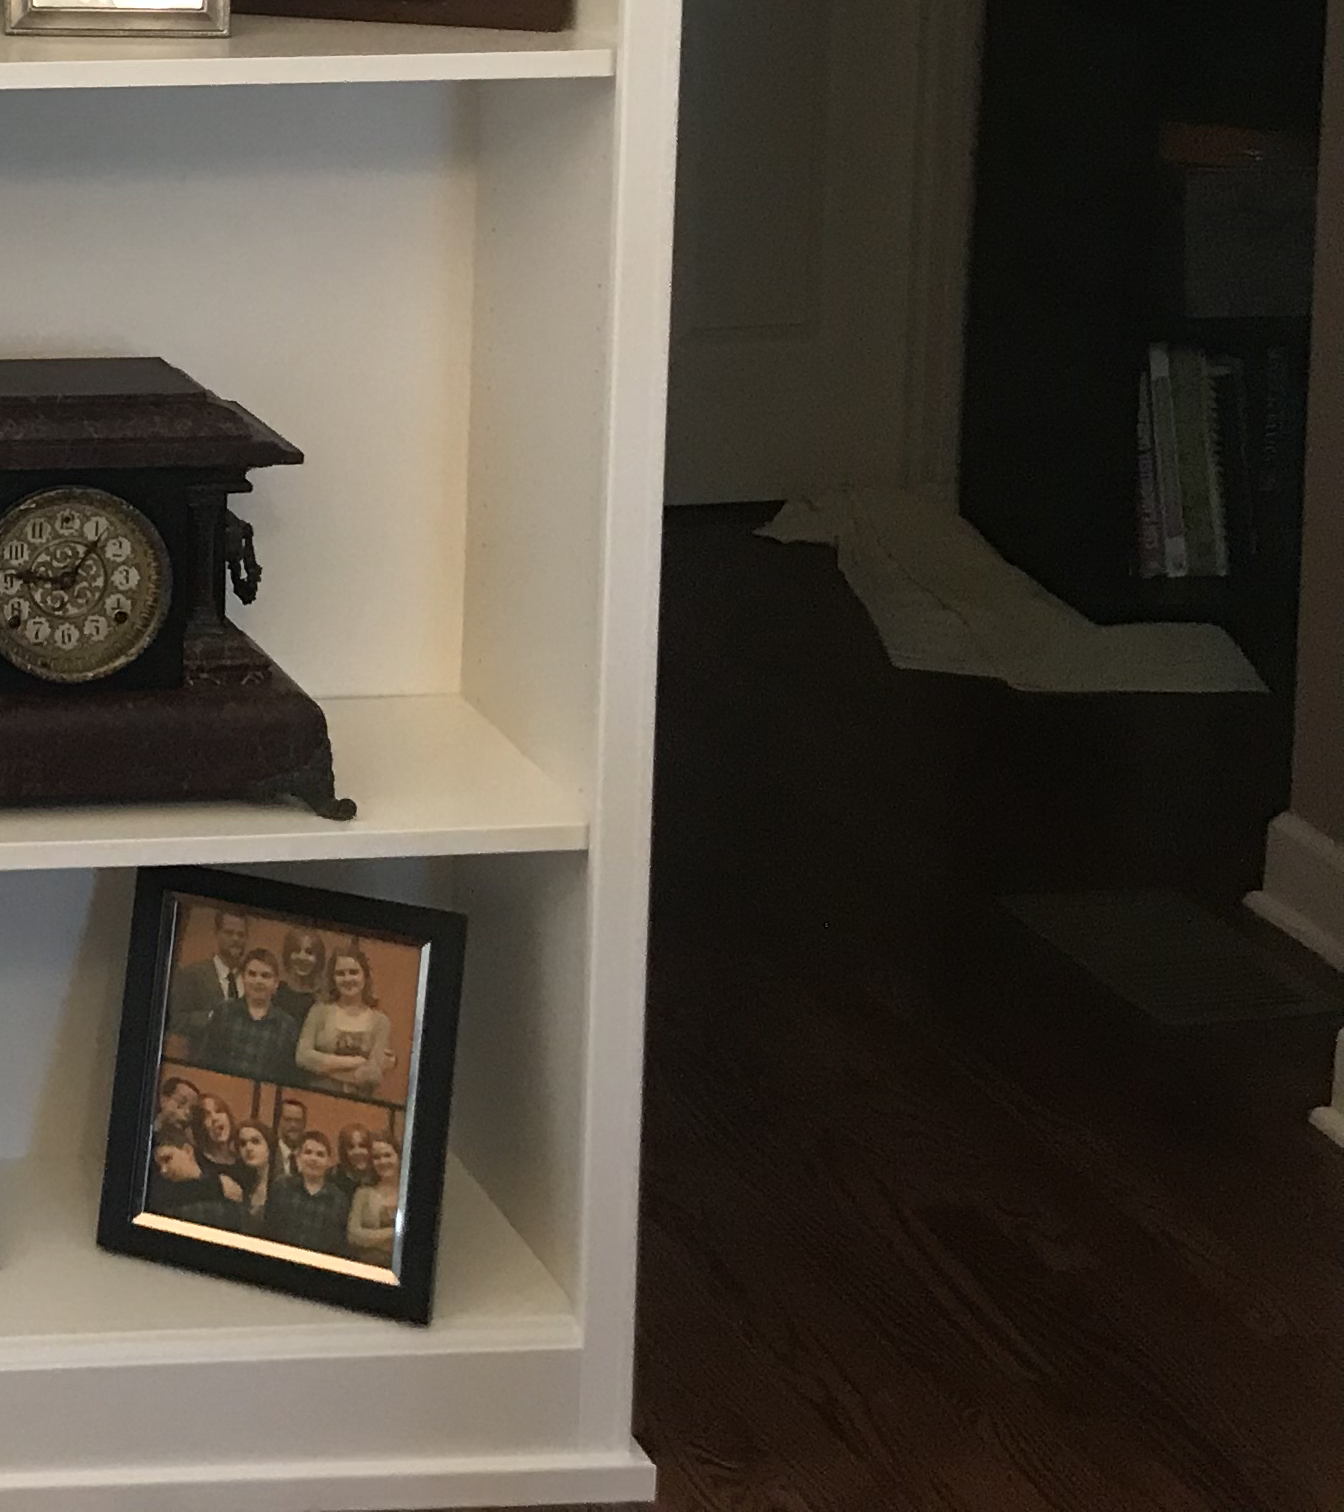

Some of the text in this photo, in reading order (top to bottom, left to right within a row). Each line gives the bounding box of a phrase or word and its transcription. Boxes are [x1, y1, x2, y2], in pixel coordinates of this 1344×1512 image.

[31, 521, 44, 539] 11
[112, 541, 124, 558] 2
[118, 569, 130, 585] 3
[32, 620, 44, 640] 7
[60, 625, 72, 645] 6
